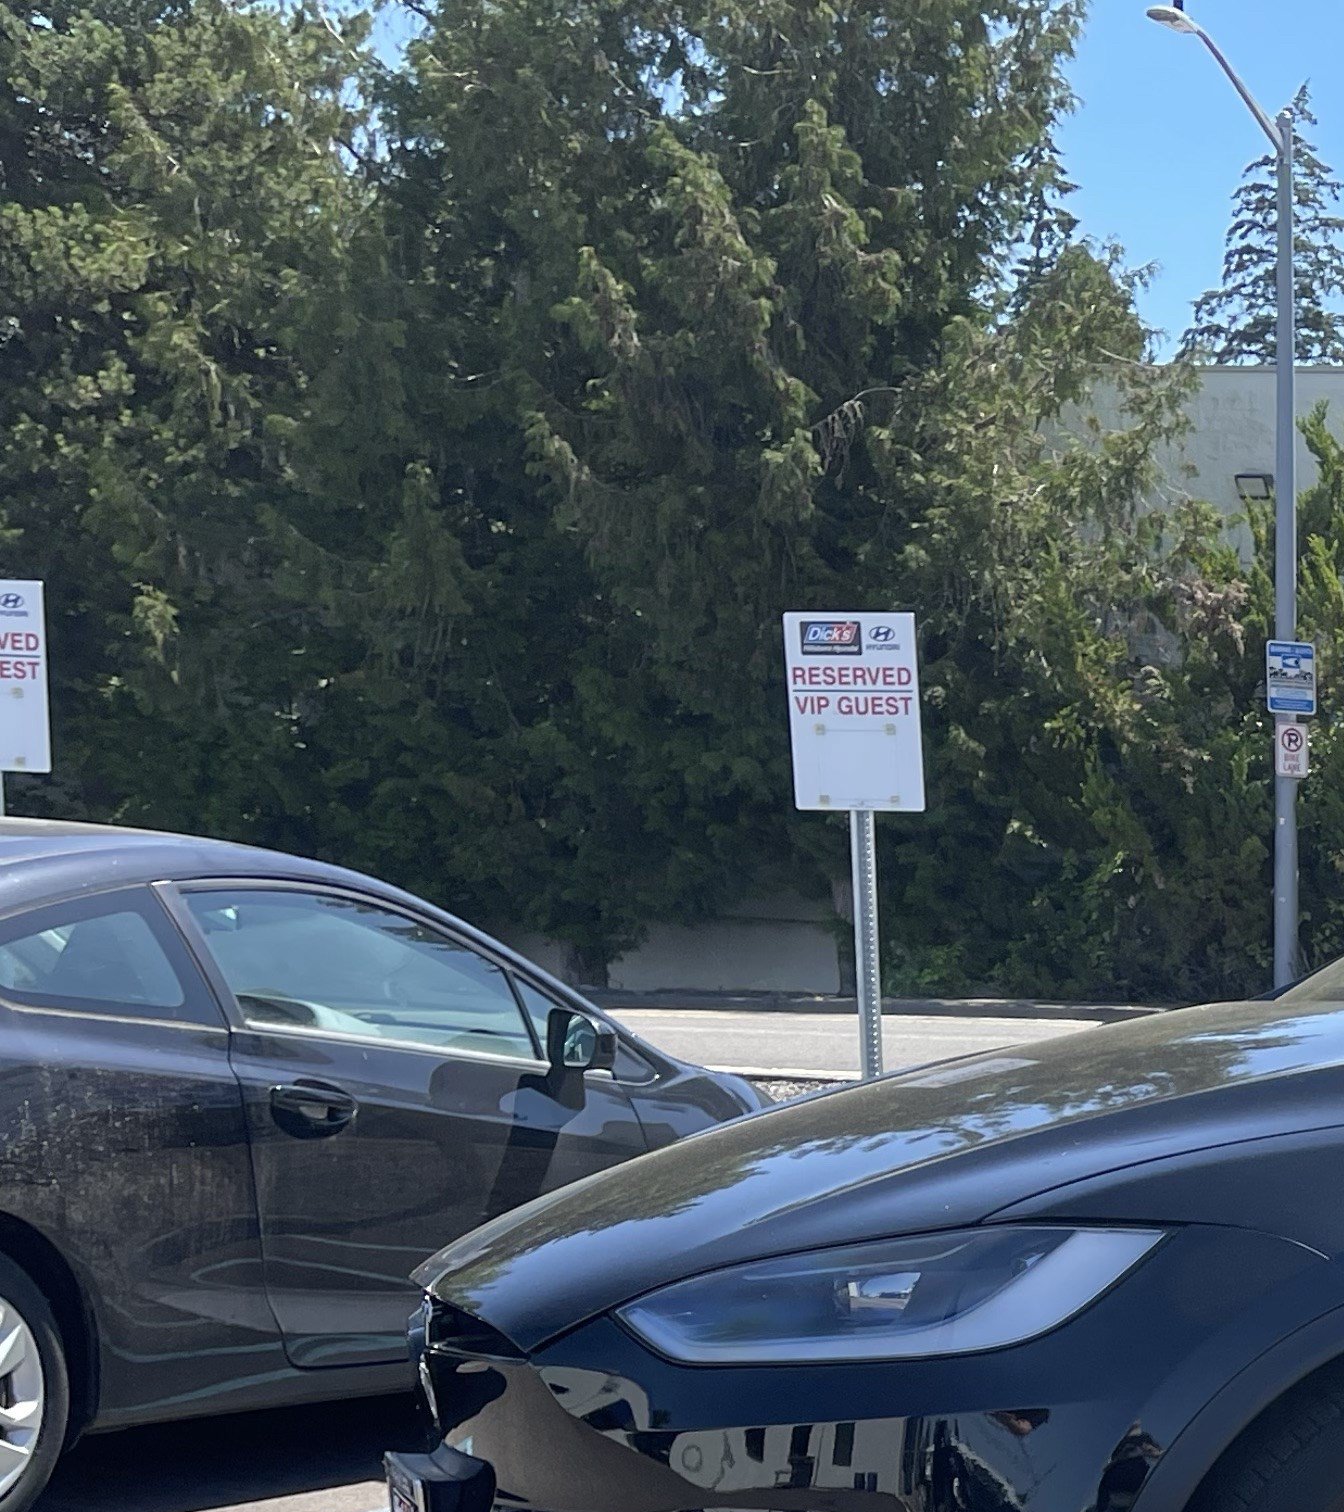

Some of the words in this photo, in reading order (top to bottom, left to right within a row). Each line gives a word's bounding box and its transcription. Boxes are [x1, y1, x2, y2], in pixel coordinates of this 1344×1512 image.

[792, 667, 912, 686] RESERVED
[794, 696, 830, 715] VIP
[837, 696, 912, 716] GUEST
